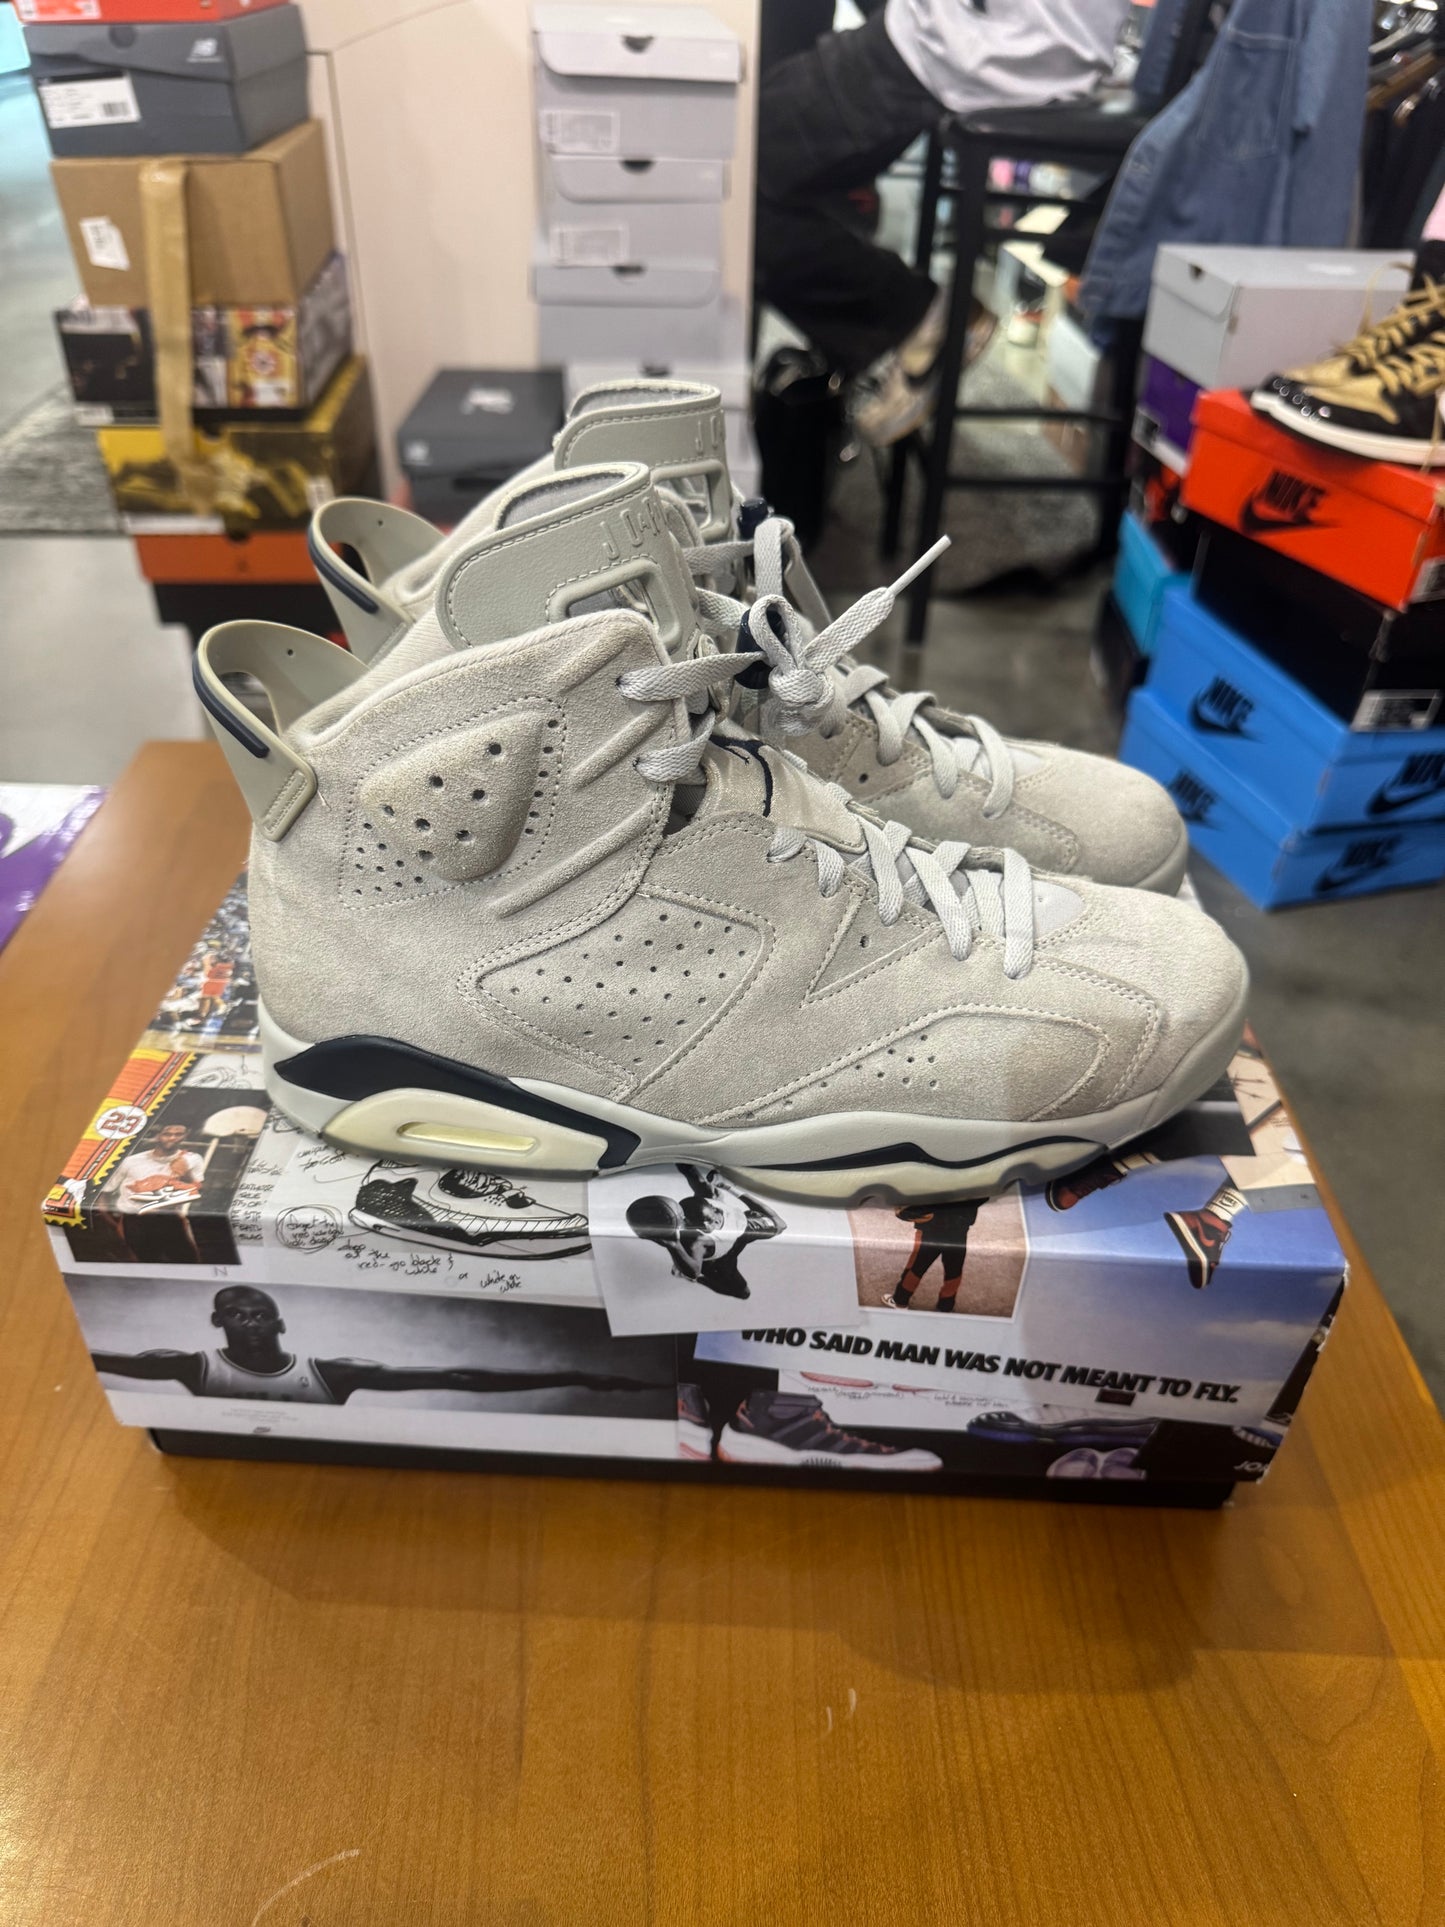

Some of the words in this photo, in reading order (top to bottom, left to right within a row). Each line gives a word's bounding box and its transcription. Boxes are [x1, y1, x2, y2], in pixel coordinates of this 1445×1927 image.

[1261, 470, 1326, 522] NIKE
[1201, 675, 1255, 729] NIKE
[101, 1111, 142, 1134] 23
[740, 1327, 806, 1346] WHO
[809, 1330, 873, 1355] SAID
[874, 1340, 941, 1365] MAN
[944, 1348, 1001, 1373] WAS
[1003, 1357, 1062, 1380] NOT
[1059, 1365, 1156, 1392] MEANT
[1157, 1377, 1191, 1397] TO
[1193, 1381, 1242, 1403] FLY.
